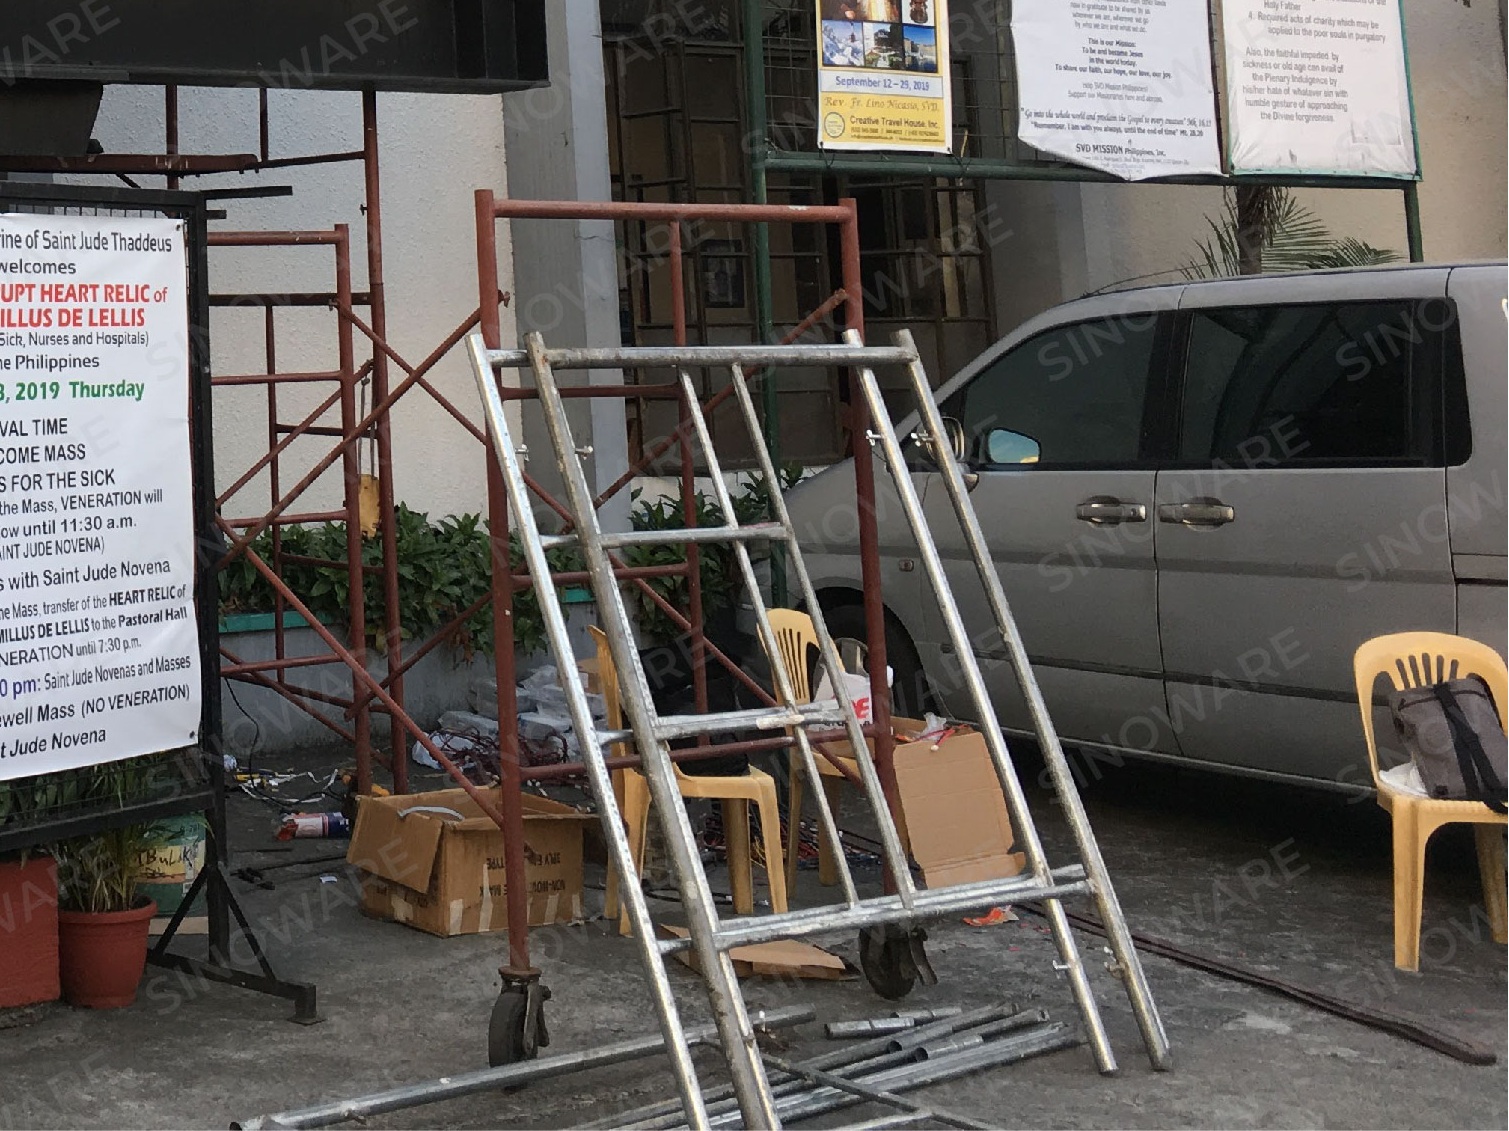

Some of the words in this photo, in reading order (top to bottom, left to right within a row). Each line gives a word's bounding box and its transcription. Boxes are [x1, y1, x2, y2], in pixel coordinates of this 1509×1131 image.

[835, 76, 881, 89] September
[883, 78, 891, 88] 12
[850, 115, 880, 125] Creative
[882, 117, 903, 126] Travel
[1092, 144, 1123, 154] MISSION
[25, 229, 40, 250] of
[42, 230, 77, 250] Saint
[79, 231, 109, 251] Jude
[110, 231, 172, 253] Thaddeus
[40, 283, 100, 303] HEART
[104, 284, 150, 303] RELIC
[153, 286, 168, 303] of
[58, 308, 83, 327] DE
[88, 308, 145, 327] LELLIS
[28, 332, 70, 346] Nurses
[72, 331, 93, 345] and
[15, 353, 100, 373] Philippines
[15, 381, 60, 401] 2019
[68, 379, 145, 402] Thursday
[31, 417, 68, 436] TIME
[44, 443, 86, 462] MASS
[11, 473, 43, 492] FOR
[45, 470, 77, 490] THE
[80, 468, 116, 487] SICK
[21, 498, 58, 514] Mass,
[60, 490, 143, 512] VENERATION
[144, 488, 163, 504] will
[22, 519, 56, 538] until
[60, 515, 103, 533] 11:30
[106, 516, 137, 530] a.m.
[23, 540, 53, 559] JUDE
[55, 535, 105, 556] NOVENA)
[8, 570, 40, 591] with
[42, 566, 80, 587] Saint
[82, 563, 117, 582] Jude
[120, 560, 171, 578] Novena
[42, 598, 79, 615] transfer
[81, 595, 91, 611] of
[93, 595, 107, 609] the
[108, 589, 146, 607] HEART
[147, 585, 176, 603] RELIC
[177, 584, 186, 599] of
[37, 622, 53, 639] DE
[55, 617, 90, 636] LELLIS
[91, 618, 101, 632] to
[101, 616, 117, 630] the
[118, 609, 163, 628] Pastoral
[165, 606, 188, 621] Hall
[75, 641, 97, 656] until
[44, 671, 70, 691] Saint
[71, 668, 93, 686] Jude
[95, 664, 136, 683] Novenas
[137, 658, 154, 677] and
[155, 655, 191, 673] Masses
[37, 703, 75, 723] Mass
[81, 697, 105, 719] (NO
[107, 683, 190, 711] VENERATION)
[9, 736, 47, 758] Jude
[51, 729, 106, 750] Novena
